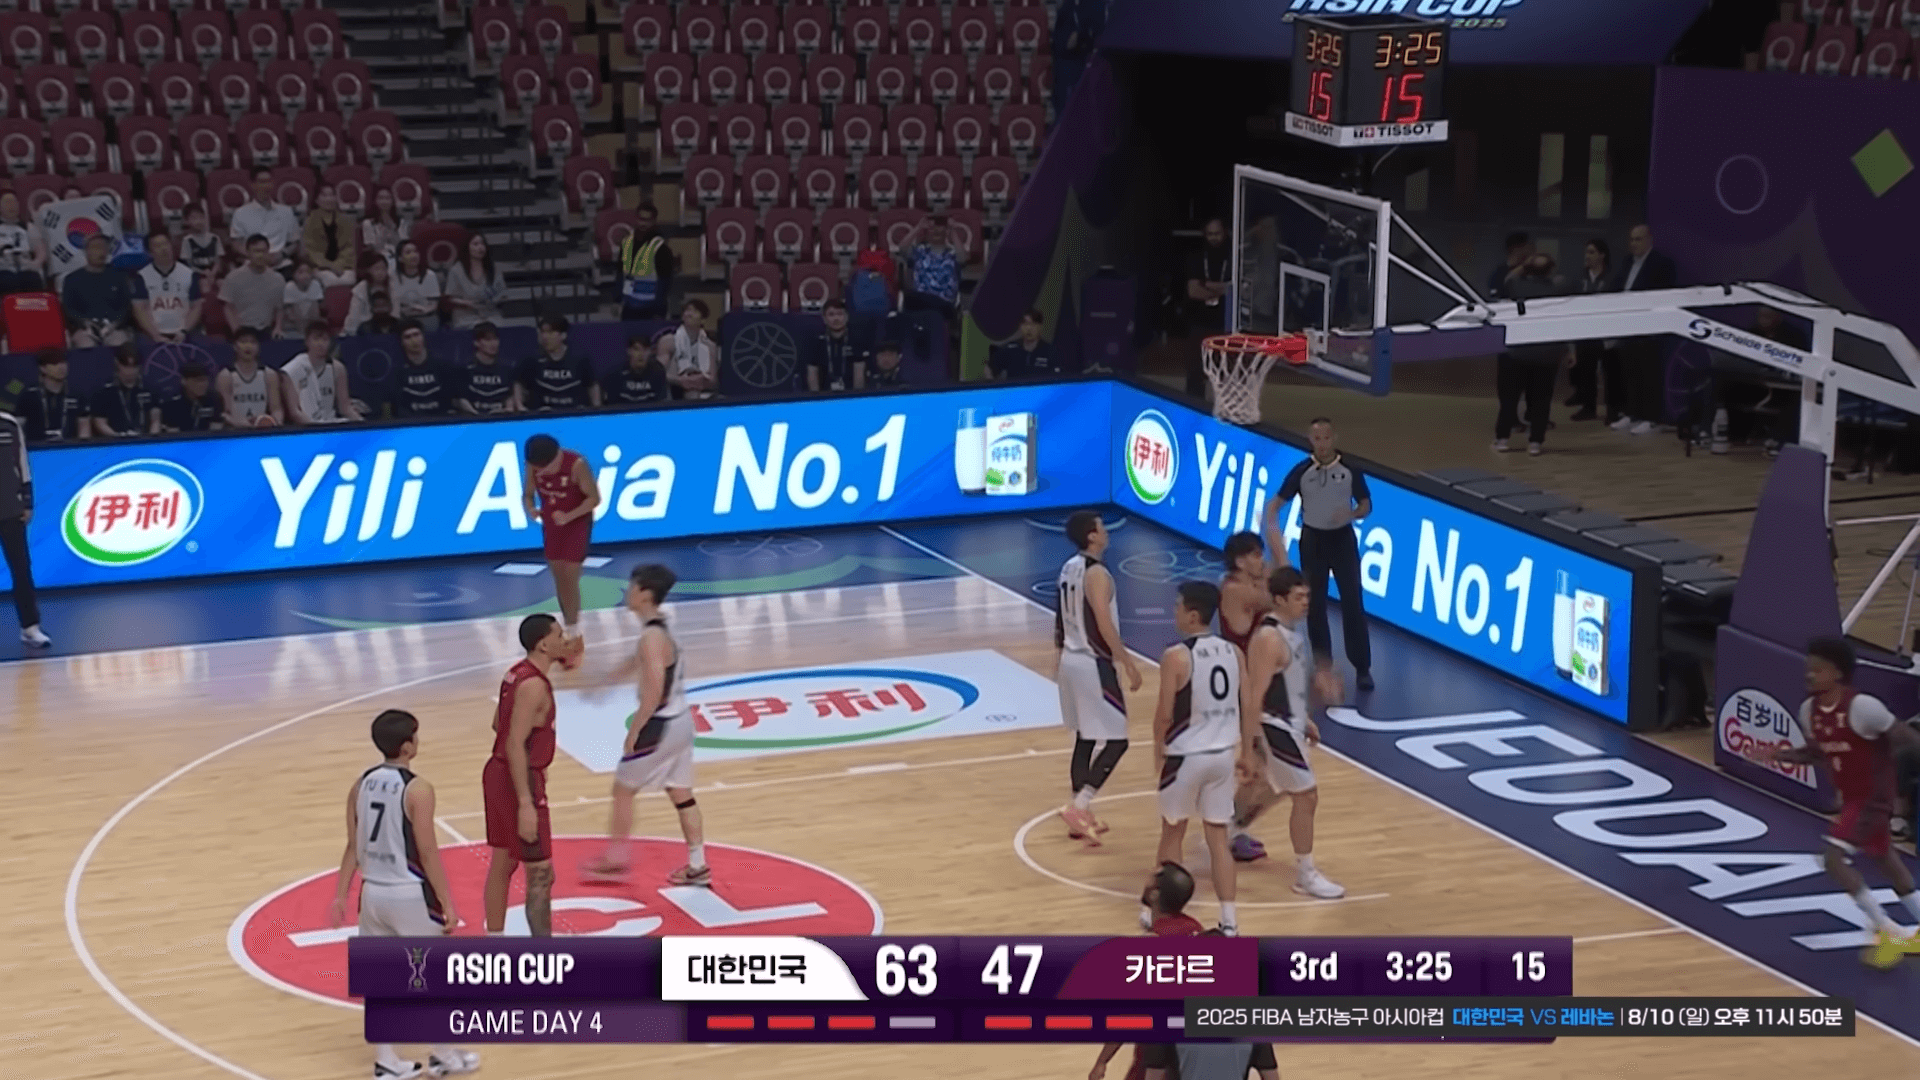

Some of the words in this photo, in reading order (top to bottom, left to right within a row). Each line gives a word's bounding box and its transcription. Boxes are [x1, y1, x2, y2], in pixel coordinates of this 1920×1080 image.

[1415, 0, 1525, 16] CUP
[1306, 29, 1342, 66] 3:25
[1374, 32, 1442, 68] 3:25
[1308, 71, 1333, 121] 15
[1380, 73, 1424, 124] 15
[1304, 120, 1335, 138] TISSOT
[1377, 123, 1435, 138] TISSOT
[153, 297, 184, 310] AIA
[1763, 343, 1803, 363] Sports
[1134, 434, 1170, 480] 伊利
[260, 450, 427, 549] Yili
[456, 440, 677, 535] Aia
[712, 414, 907, 515] No.1
[85, 490, 181, 535] 伊利
[1194, 432, 1268, 539] Yili
[1411, 517, 1534, 654] No.1
[1061, 582, 1077, 617] 11
[1209, 664, 1230, 702] 0
[691, 683, 927, 735] 伊利
[1736, 695, 1791, 738] 百岁山
[369, 801, 386, 843] 7
